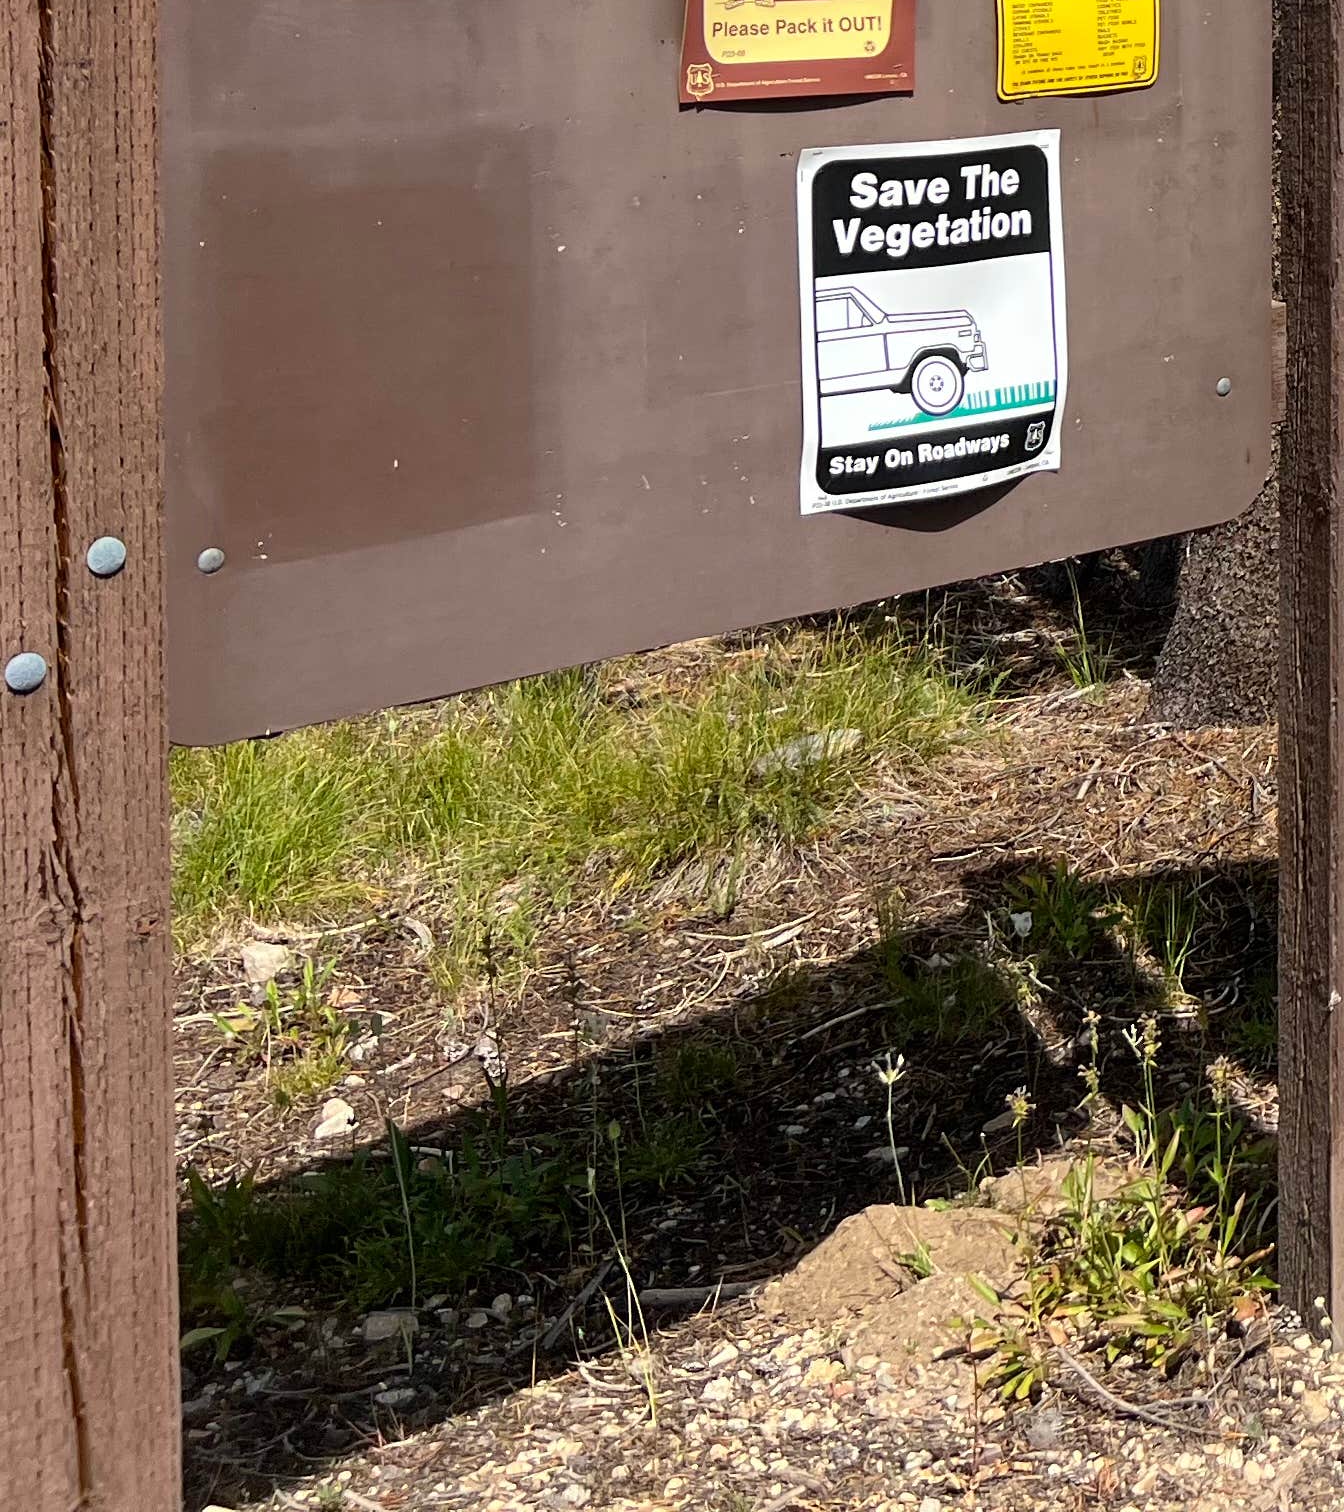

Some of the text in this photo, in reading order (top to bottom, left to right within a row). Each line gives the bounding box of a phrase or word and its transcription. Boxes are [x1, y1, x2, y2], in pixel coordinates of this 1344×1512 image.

[712, 16, 882, 38] Please Pack it OUT!
[849, 164, 1020, 210] Save The
[833, 207, 1033, 258] Vegetation
[829, 433, 1010, 476] Stay On Roadways
